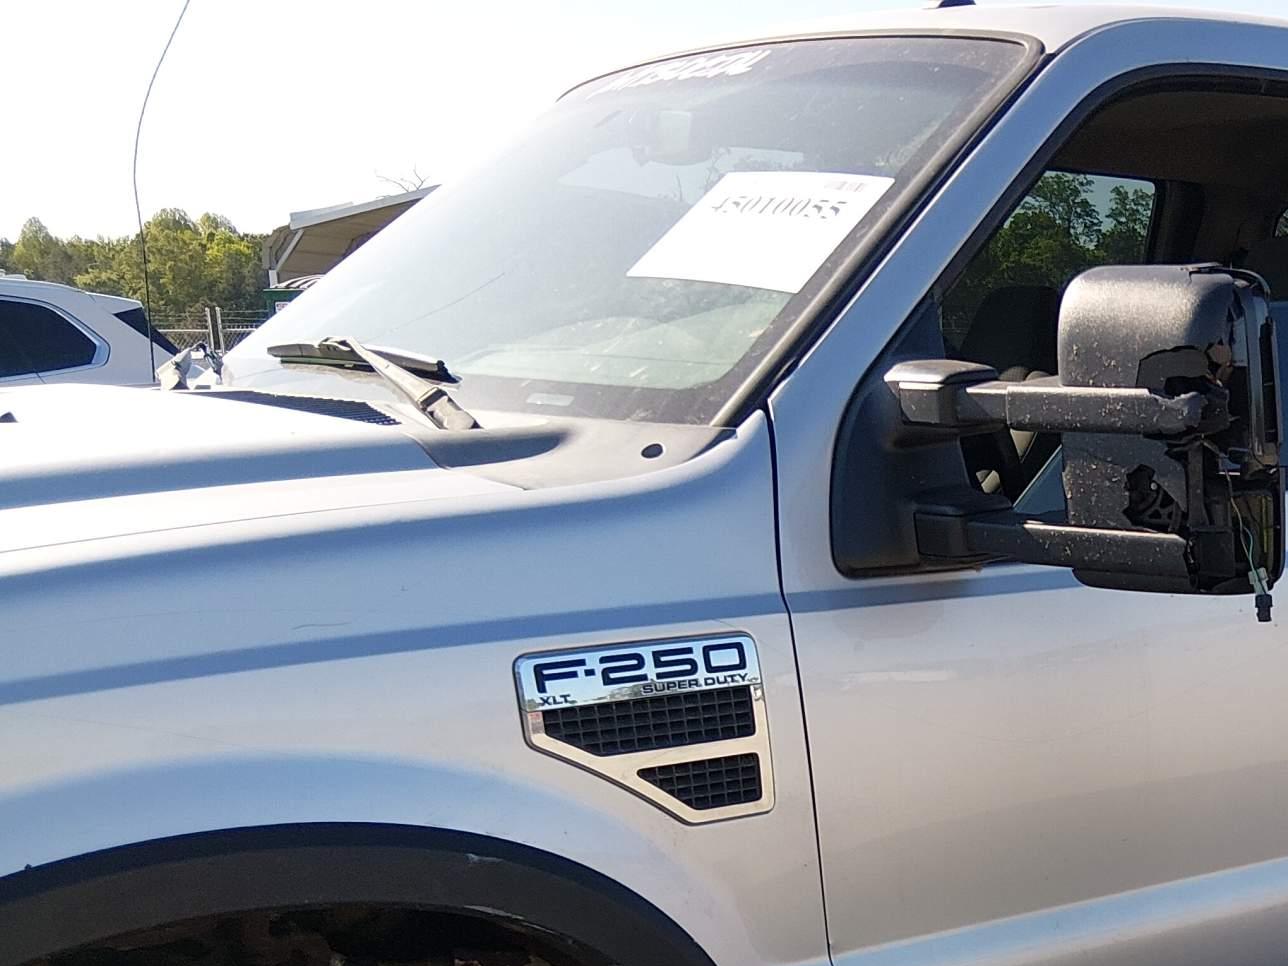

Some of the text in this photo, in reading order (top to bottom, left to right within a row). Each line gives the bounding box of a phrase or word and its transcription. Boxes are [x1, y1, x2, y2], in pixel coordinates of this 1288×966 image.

[533, 641, 747, 694] F-250
[642, 673, 749, 695] SUPER DUTY
[540, 694, 571, 707] XLT
